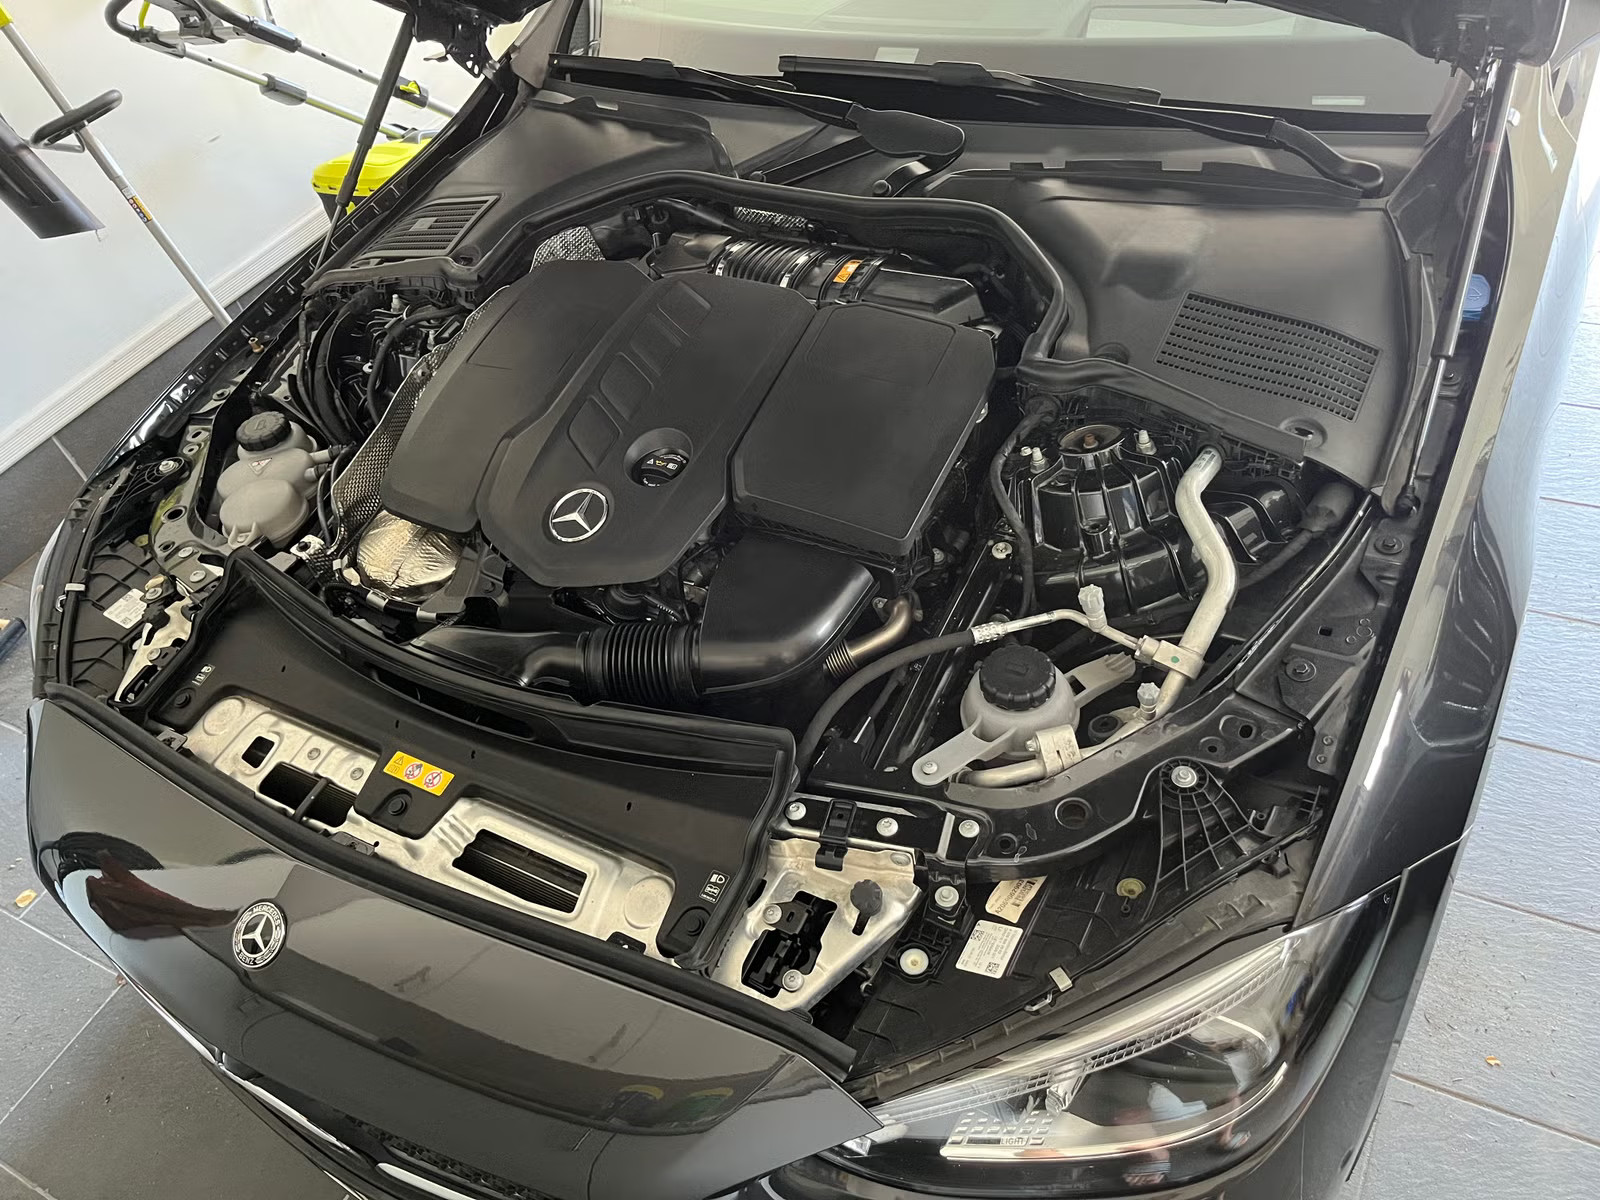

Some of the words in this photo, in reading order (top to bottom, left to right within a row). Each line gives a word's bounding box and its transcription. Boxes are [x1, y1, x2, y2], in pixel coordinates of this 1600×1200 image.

[253, 905, 281, 926] MERCEDES
[239, 952, 255, 965] BENZ
[1001, 1137, 1024, 1145] LIGHT
